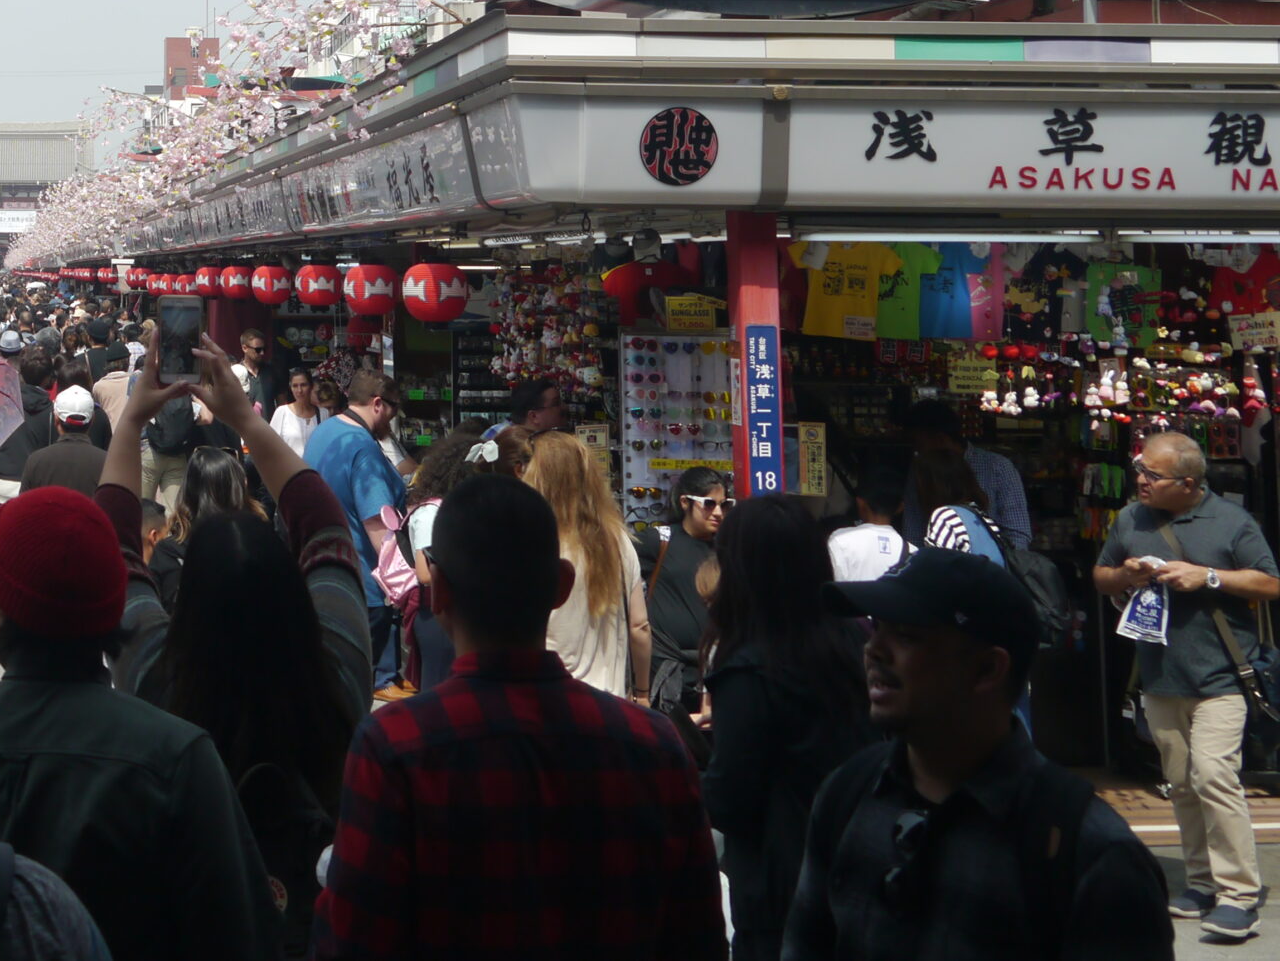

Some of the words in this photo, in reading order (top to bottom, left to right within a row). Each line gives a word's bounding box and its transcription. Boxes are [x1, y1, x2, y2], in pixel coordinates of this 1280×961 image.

[988, 165, 1177, 192] ASAKUSA
[755, 364, 772, 458] 浅草一丁目
[755, 471, 777, 491] 18
